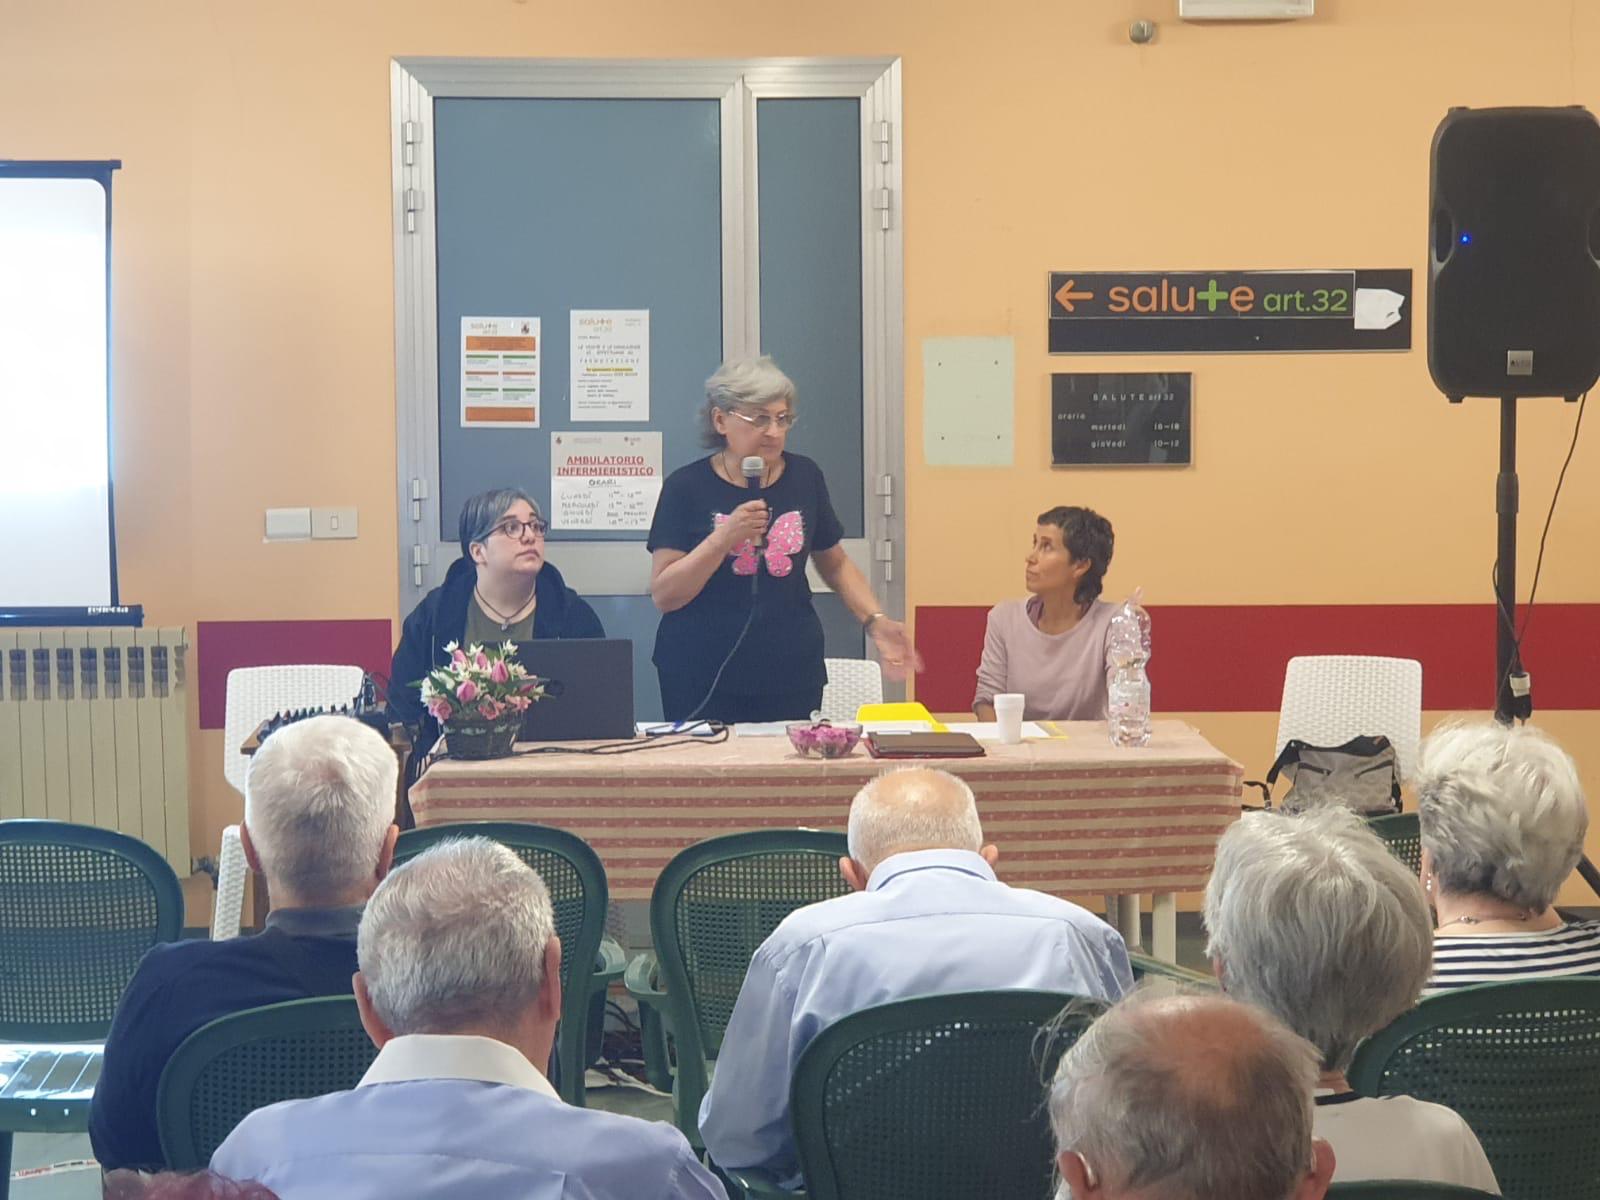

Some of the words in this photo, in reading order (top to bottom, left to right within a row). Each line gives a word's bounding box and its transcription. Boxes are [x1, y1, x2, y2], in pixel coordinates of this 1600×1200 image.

[1263, 289, 1348, 313] art.32
[566, 455, 645, 466] AMBULATORIO
[556, 466, 654, 477] INFERMIERISTICO
